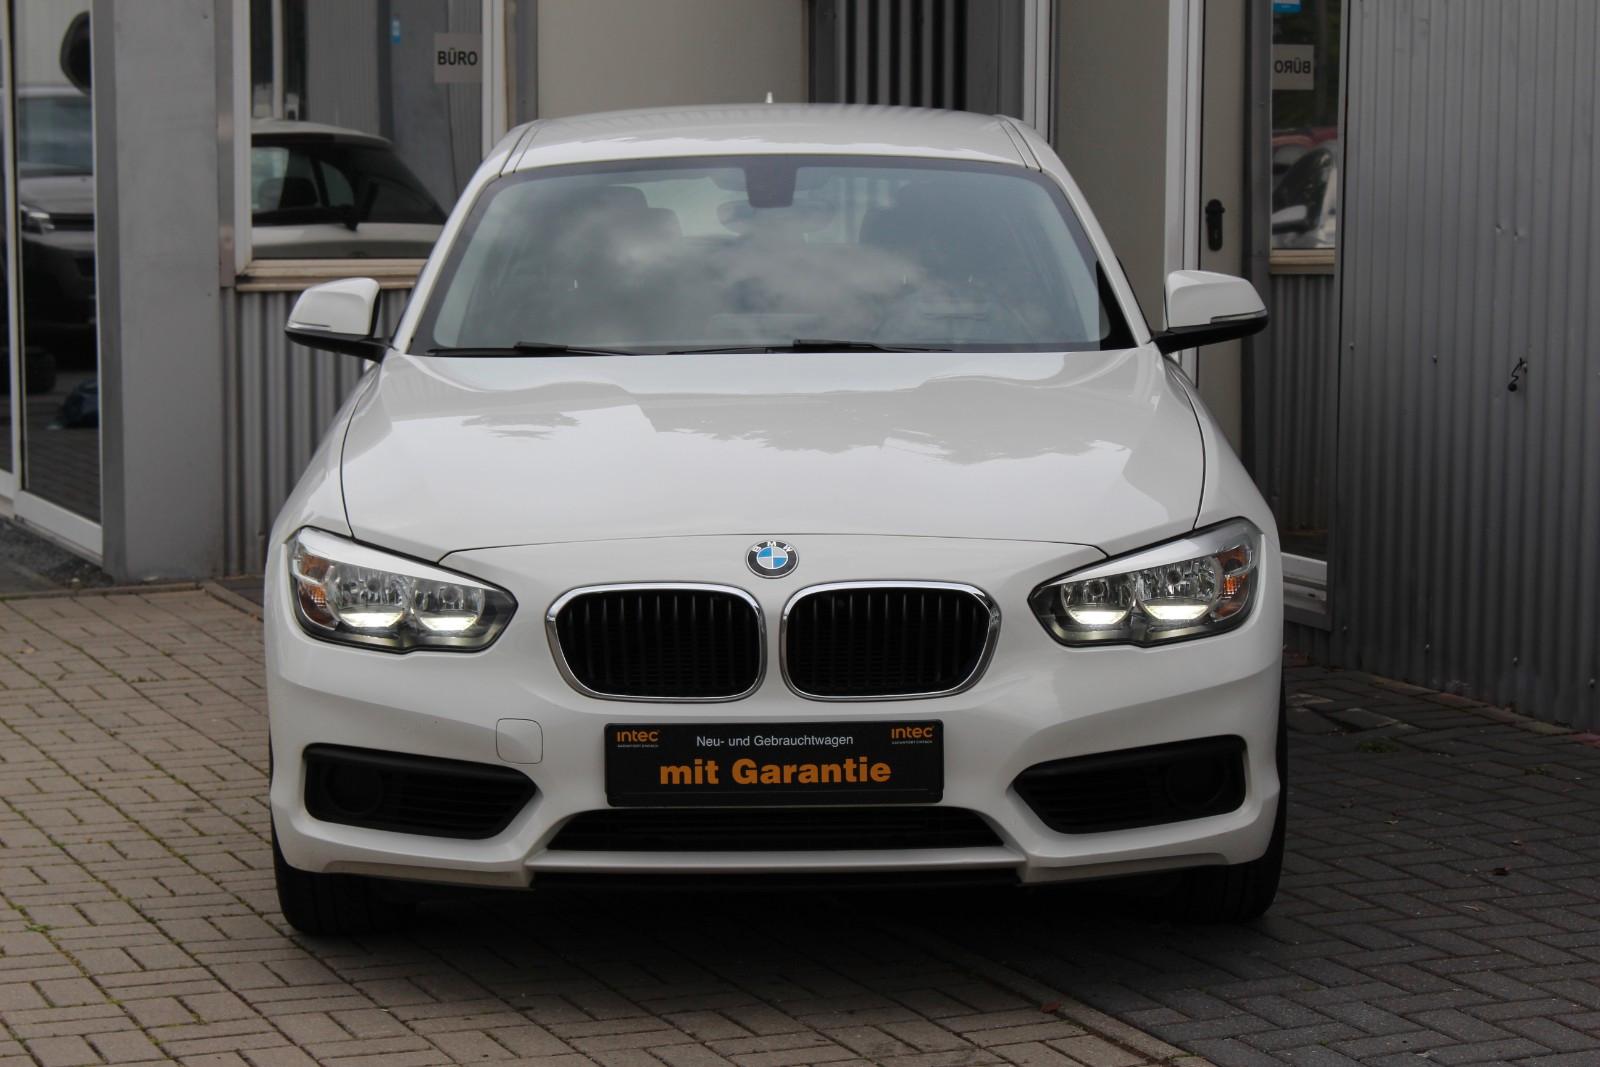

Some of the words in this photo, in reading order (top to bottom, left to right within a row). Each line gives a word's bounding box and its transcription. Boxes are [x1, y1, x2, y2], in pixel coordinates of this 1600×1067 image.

[437, 47, 478, 66] BÜRO
[751, 540, 793, 553] BMW
[616, 729, 659, 743] intec
[890, 725, 934, 739] intec
[696, 735, 725, 747] Neu-
[728, 735, 750, 747] und
[753, 734, 854, 748] Gebrauchtwagen
[659, 758, 719, 785] mit
[731, 756, 892, 785] Garantie
